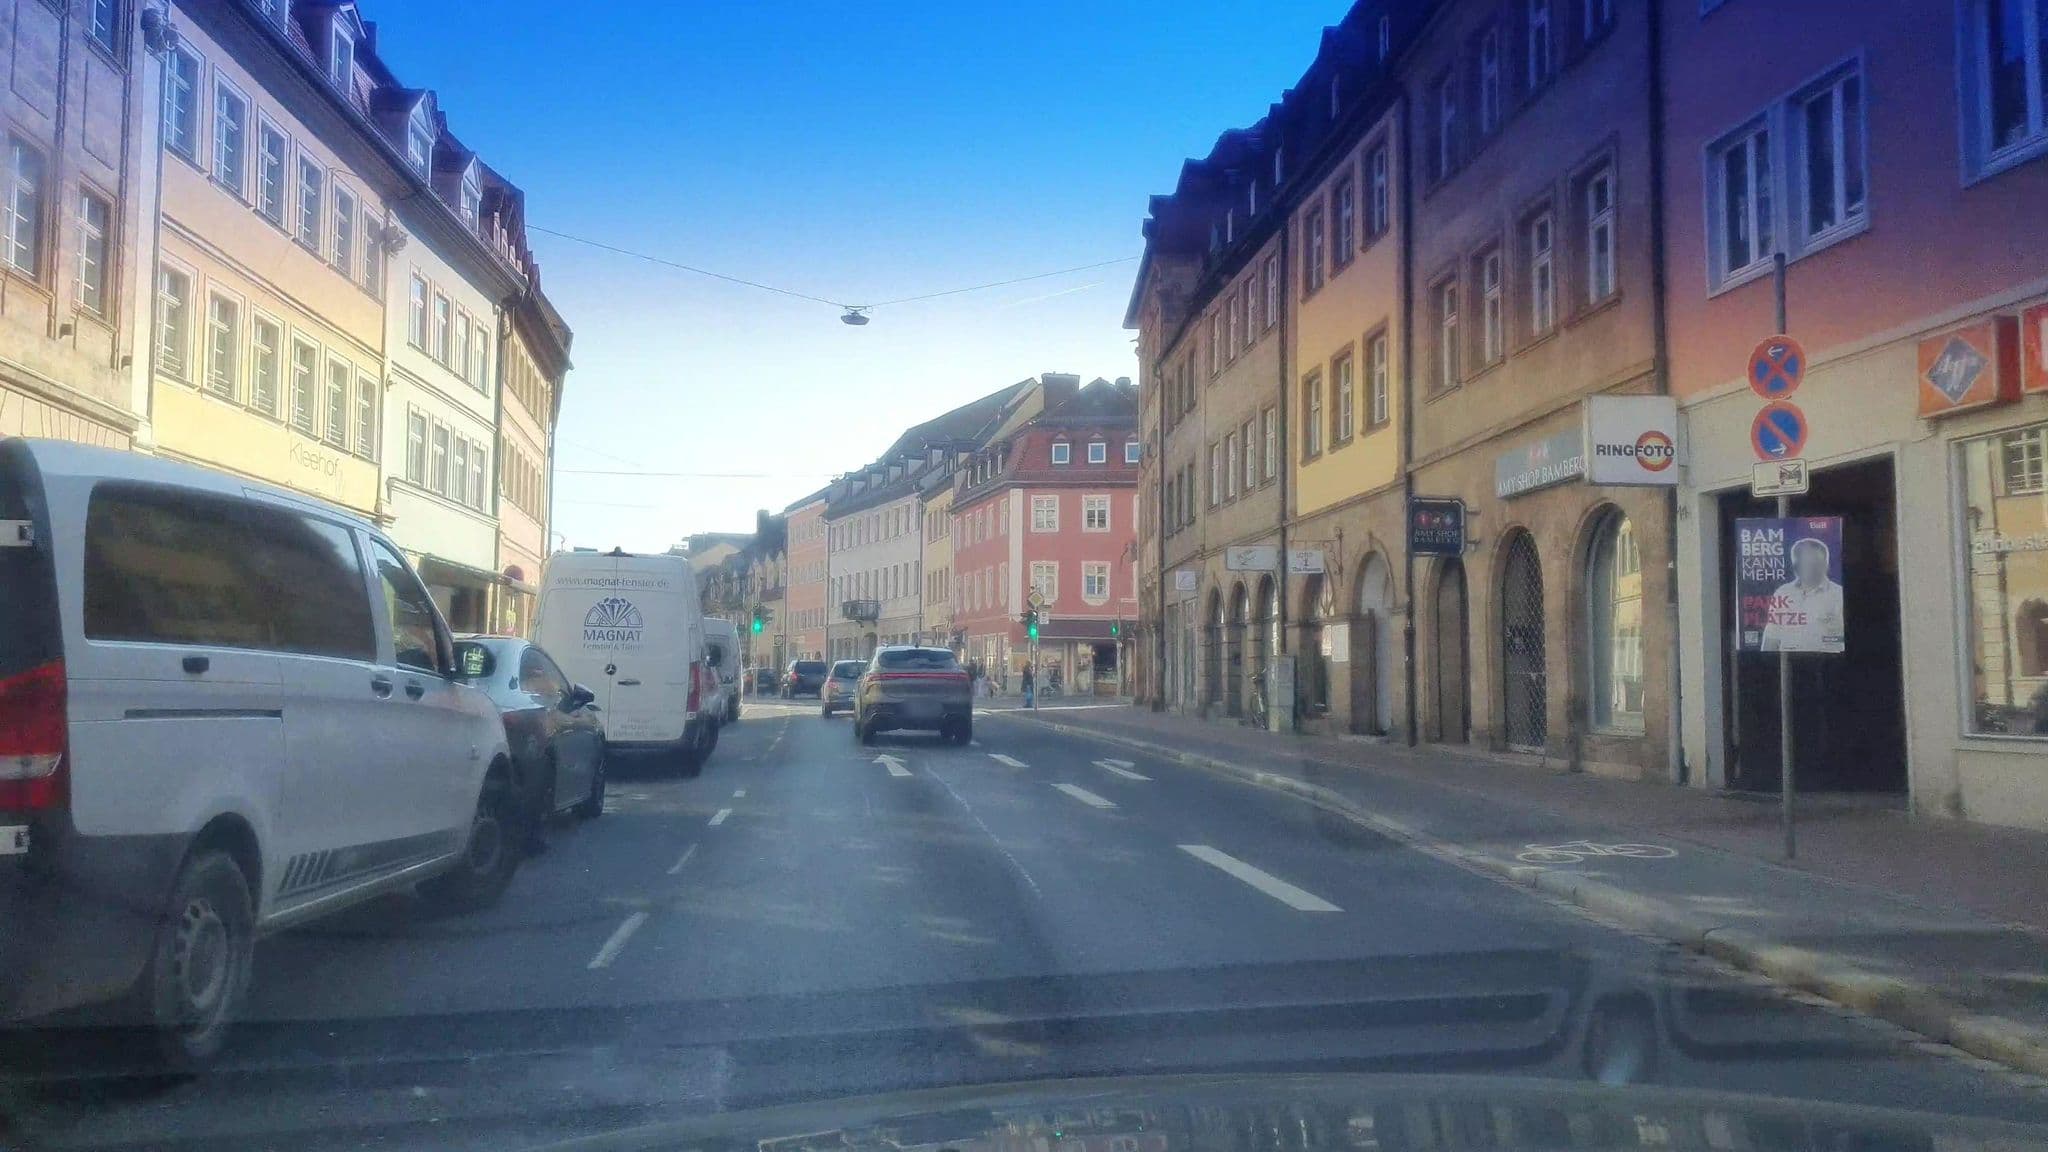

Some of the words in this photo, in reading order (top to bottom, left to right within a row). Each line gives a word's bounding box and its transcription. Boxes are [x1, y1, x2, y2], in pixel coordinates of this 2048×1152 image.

[1596, 444, 1675, 457] RINGFOTO
[289, 440, 340, 477] Kleehof
[1518, 468, 1541, 491] SHOP
[1741, 528, 1784, 542] BAM
[1742, 542, 1784, 556] BERG
[1742, 557, 1785, 569] KANN
[1743, 569, 1786, 580] MEHR
[584, 630, 642, 641] MAGNAT
